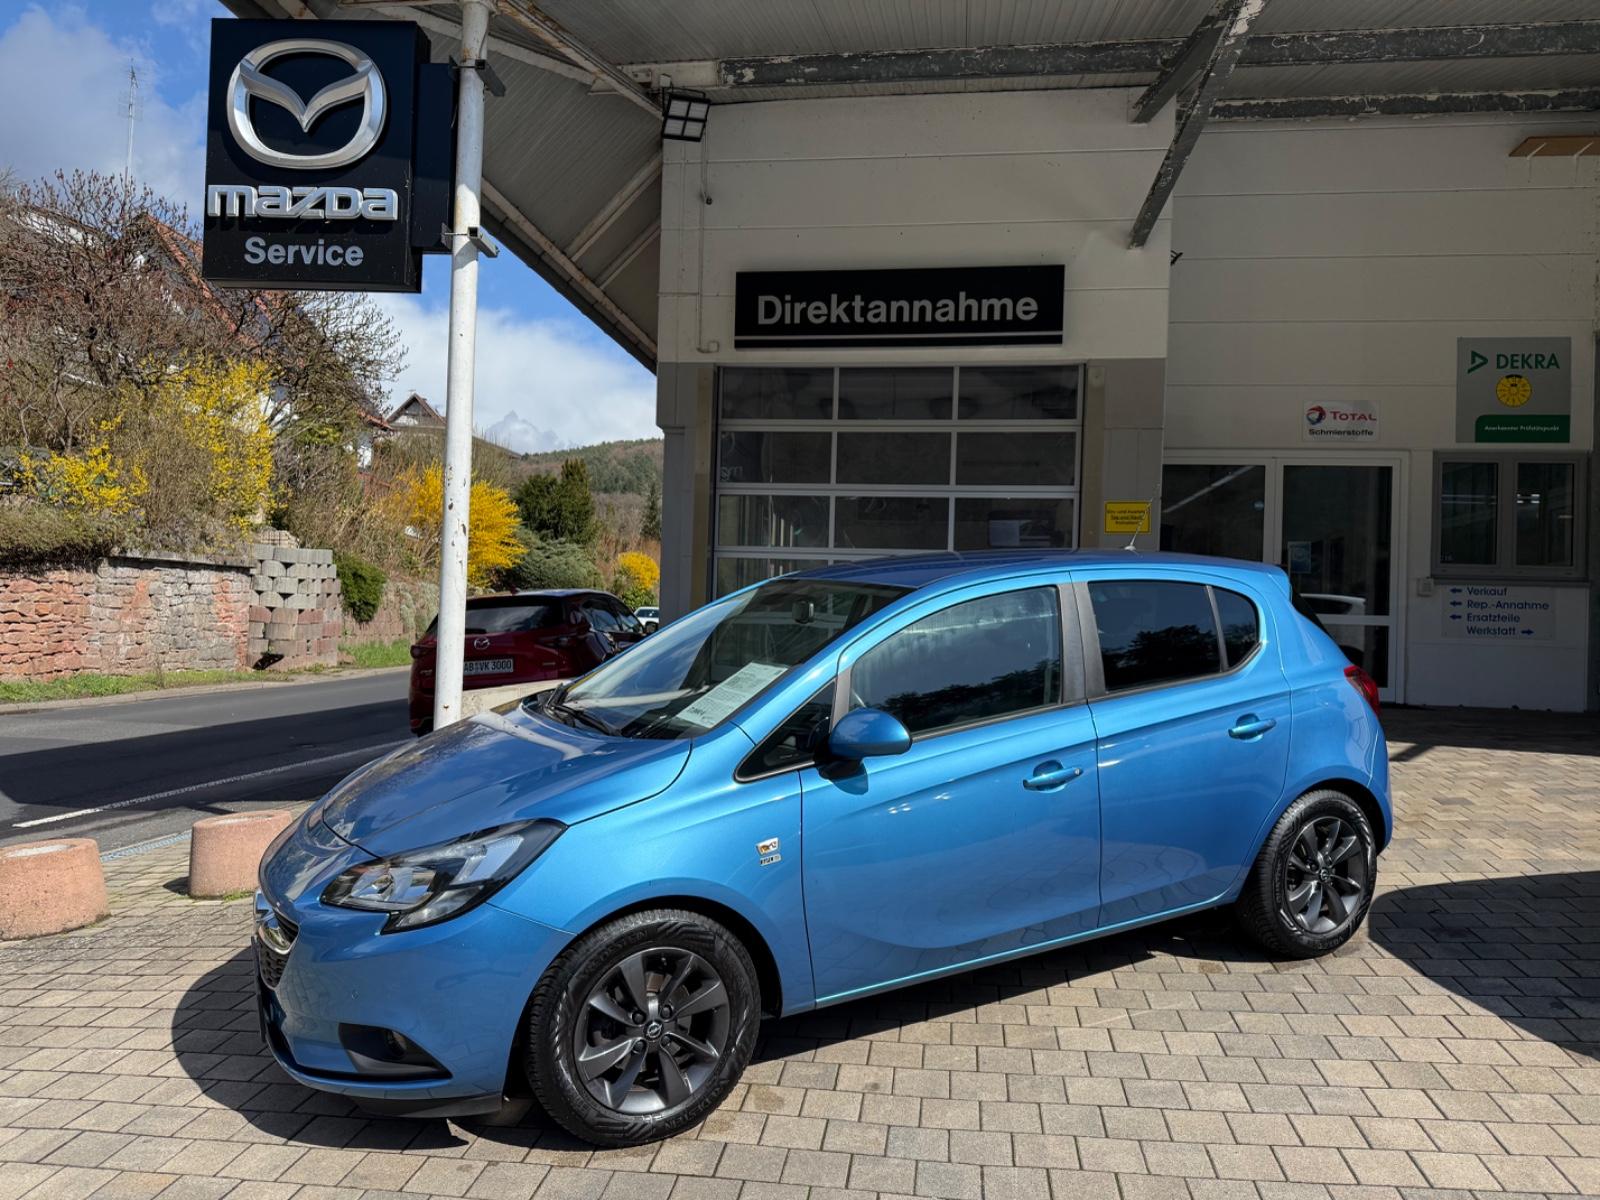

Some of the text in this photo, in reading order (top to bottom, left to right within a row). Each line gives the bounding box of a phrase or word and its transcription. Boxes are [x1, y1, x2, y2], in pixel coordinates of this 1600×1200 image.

[208, 184, 398, 221] mazda
[244, 236, 364, 267] Service
[757, 291, 1039, 325] Direktannahme
[1496, 353, 1560, 370] DEKRA
[1330, 411, 1377, 421] TOTAL
[1308, 428, 1374, 436] Schmierstoffe
[1466, 587, 1508, 596] Verkauf
[1466, 600, 1550, 611] Rep.-Annahme
[1466, 613, 1521, 623] Ersatzteile
[1466, 625, 1516, 636] Werkstatt
[479, 662, 489, 671] VK
[491, 660, 511, 670] 3000
